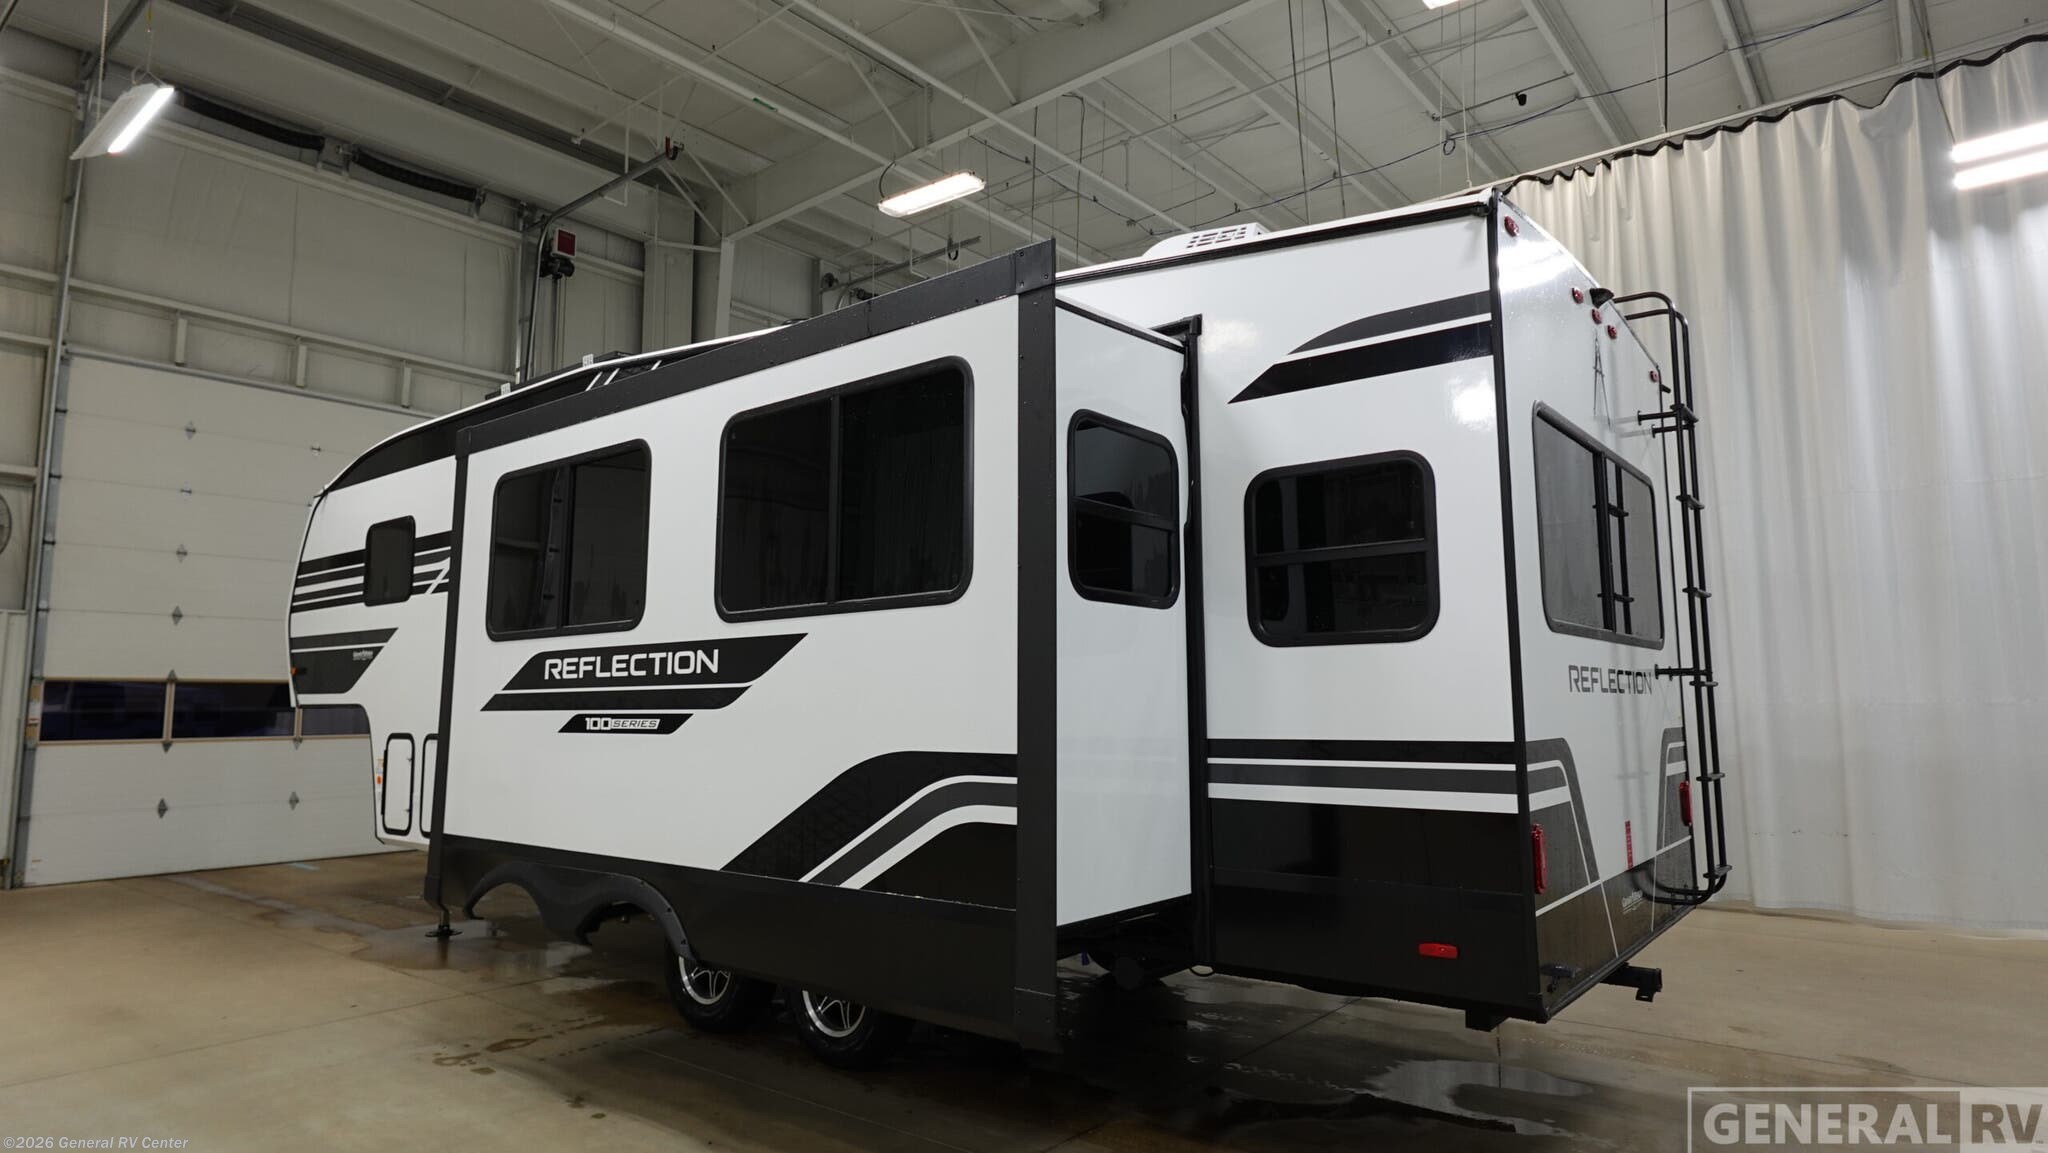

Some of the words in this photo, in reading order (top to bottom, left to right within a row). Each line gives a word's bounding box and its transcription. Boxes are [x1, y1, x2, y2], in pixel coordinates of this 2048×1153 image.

[544, 649, 719, 680] REFLECTION
[1568, 664, 1653, 695] REFLECTION
[585, 717, 612, 730] 100
[612, 719, 658, 729] SERIES
